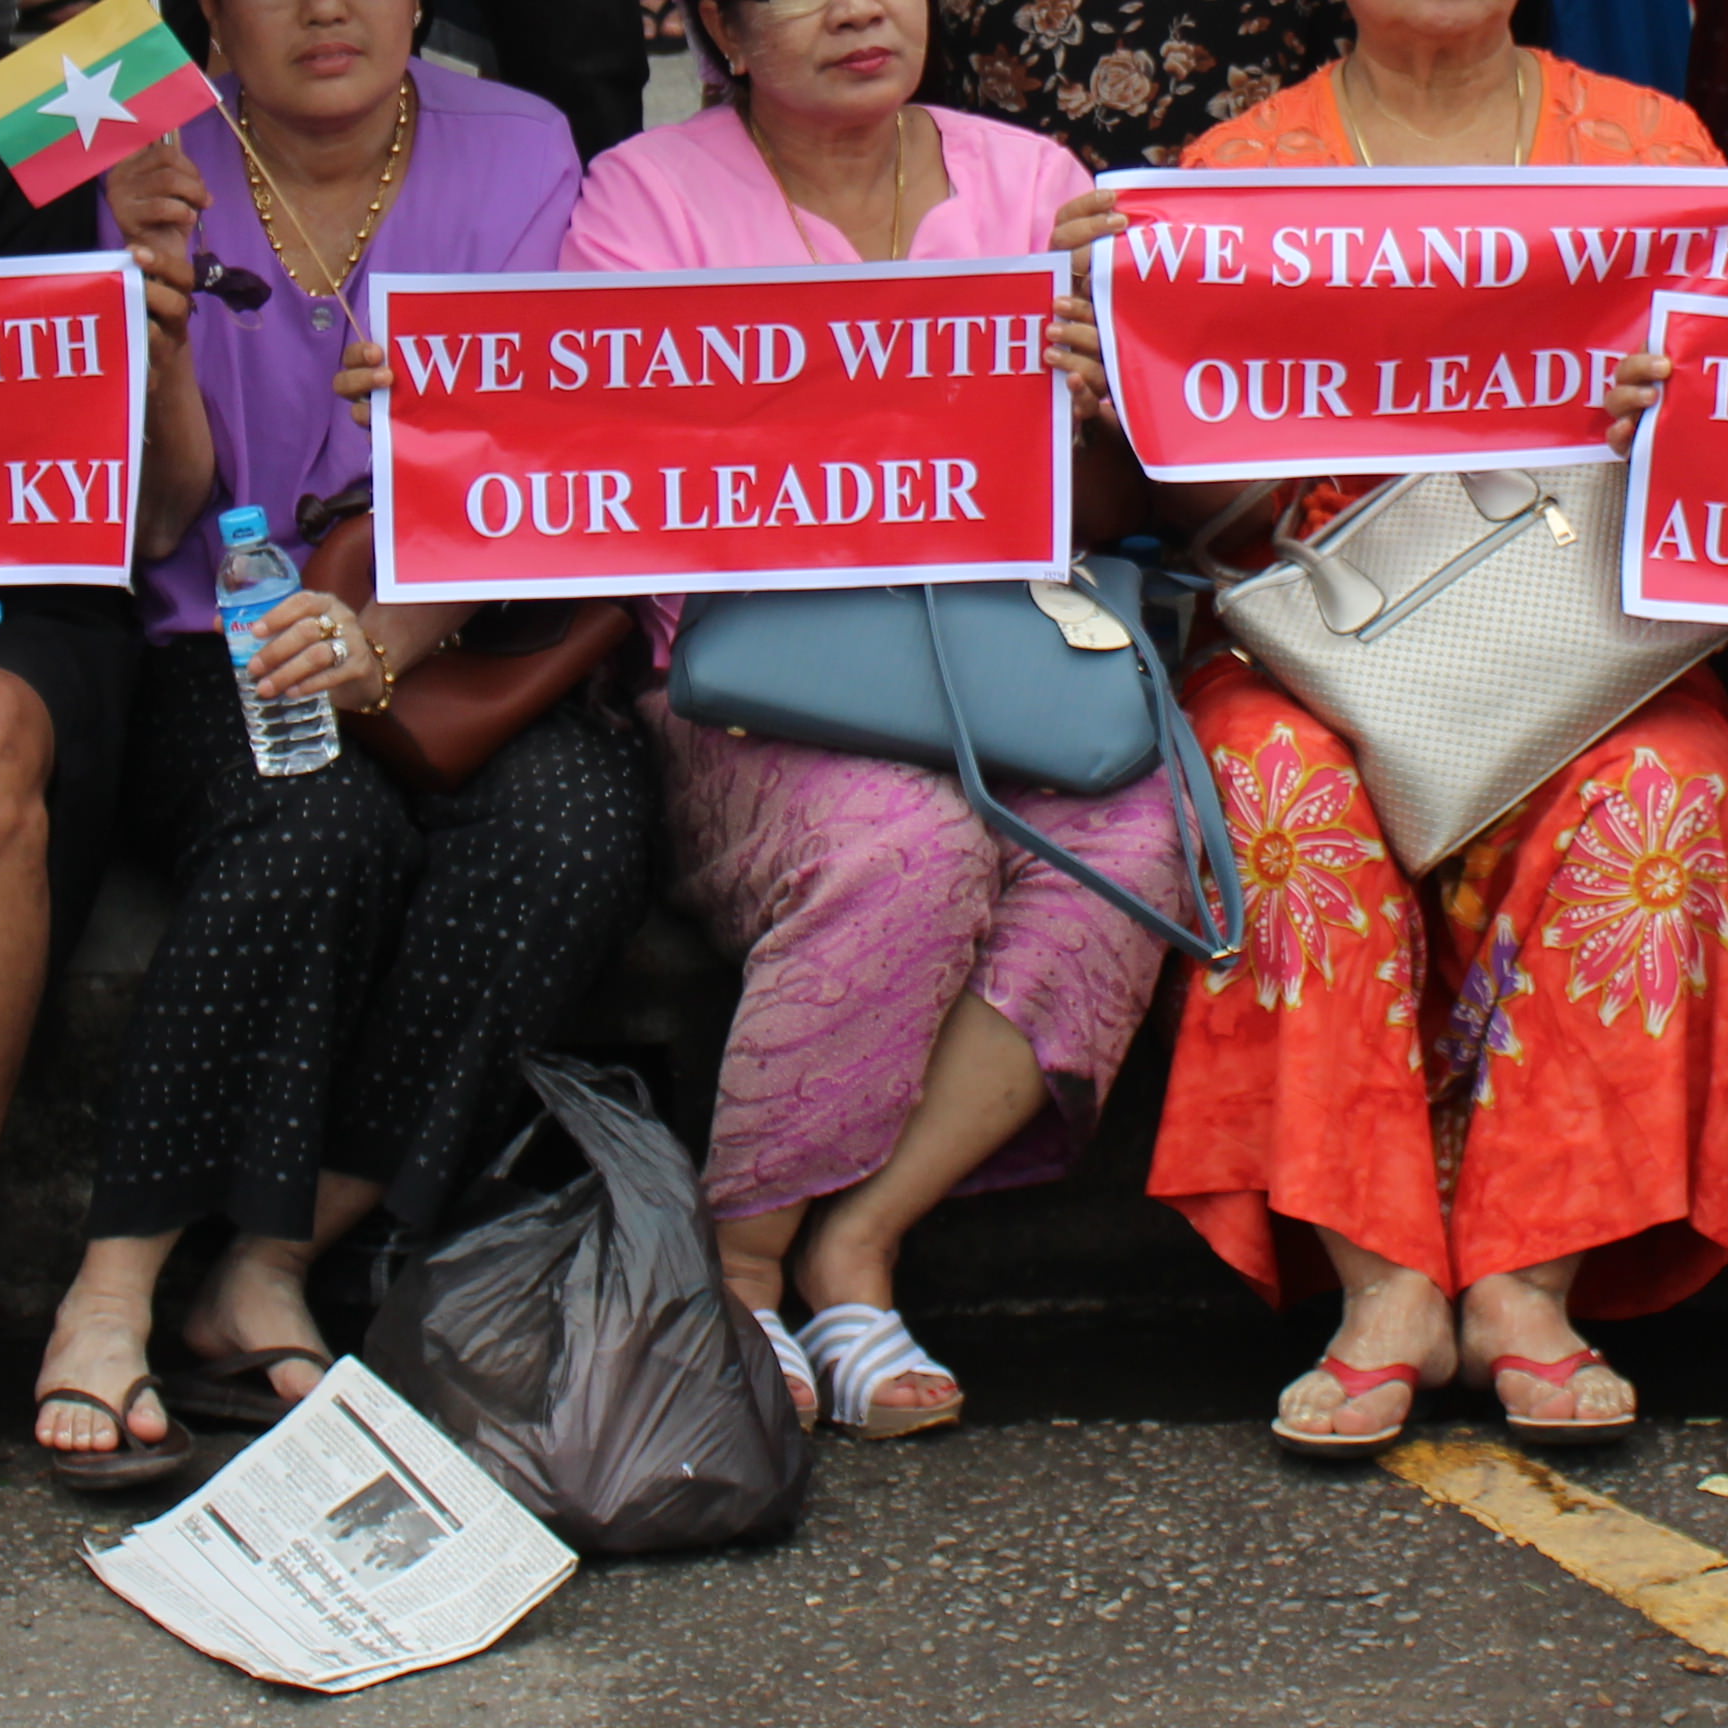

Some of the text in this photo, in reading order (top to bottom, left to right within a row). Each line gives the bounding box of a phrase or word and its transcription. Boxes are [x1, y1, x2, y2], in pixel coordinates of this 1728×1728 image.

[1127, 221, 1247, 283] WE
[1273, 226, 1528, 286] STAND
[396, 315, 1048, 395] WE STAND WITH
[1184, 360, 1352, 422] OUR
[7, 461, 122, 523] KYI
[467, 459, 984, 537] OUR LEADER
